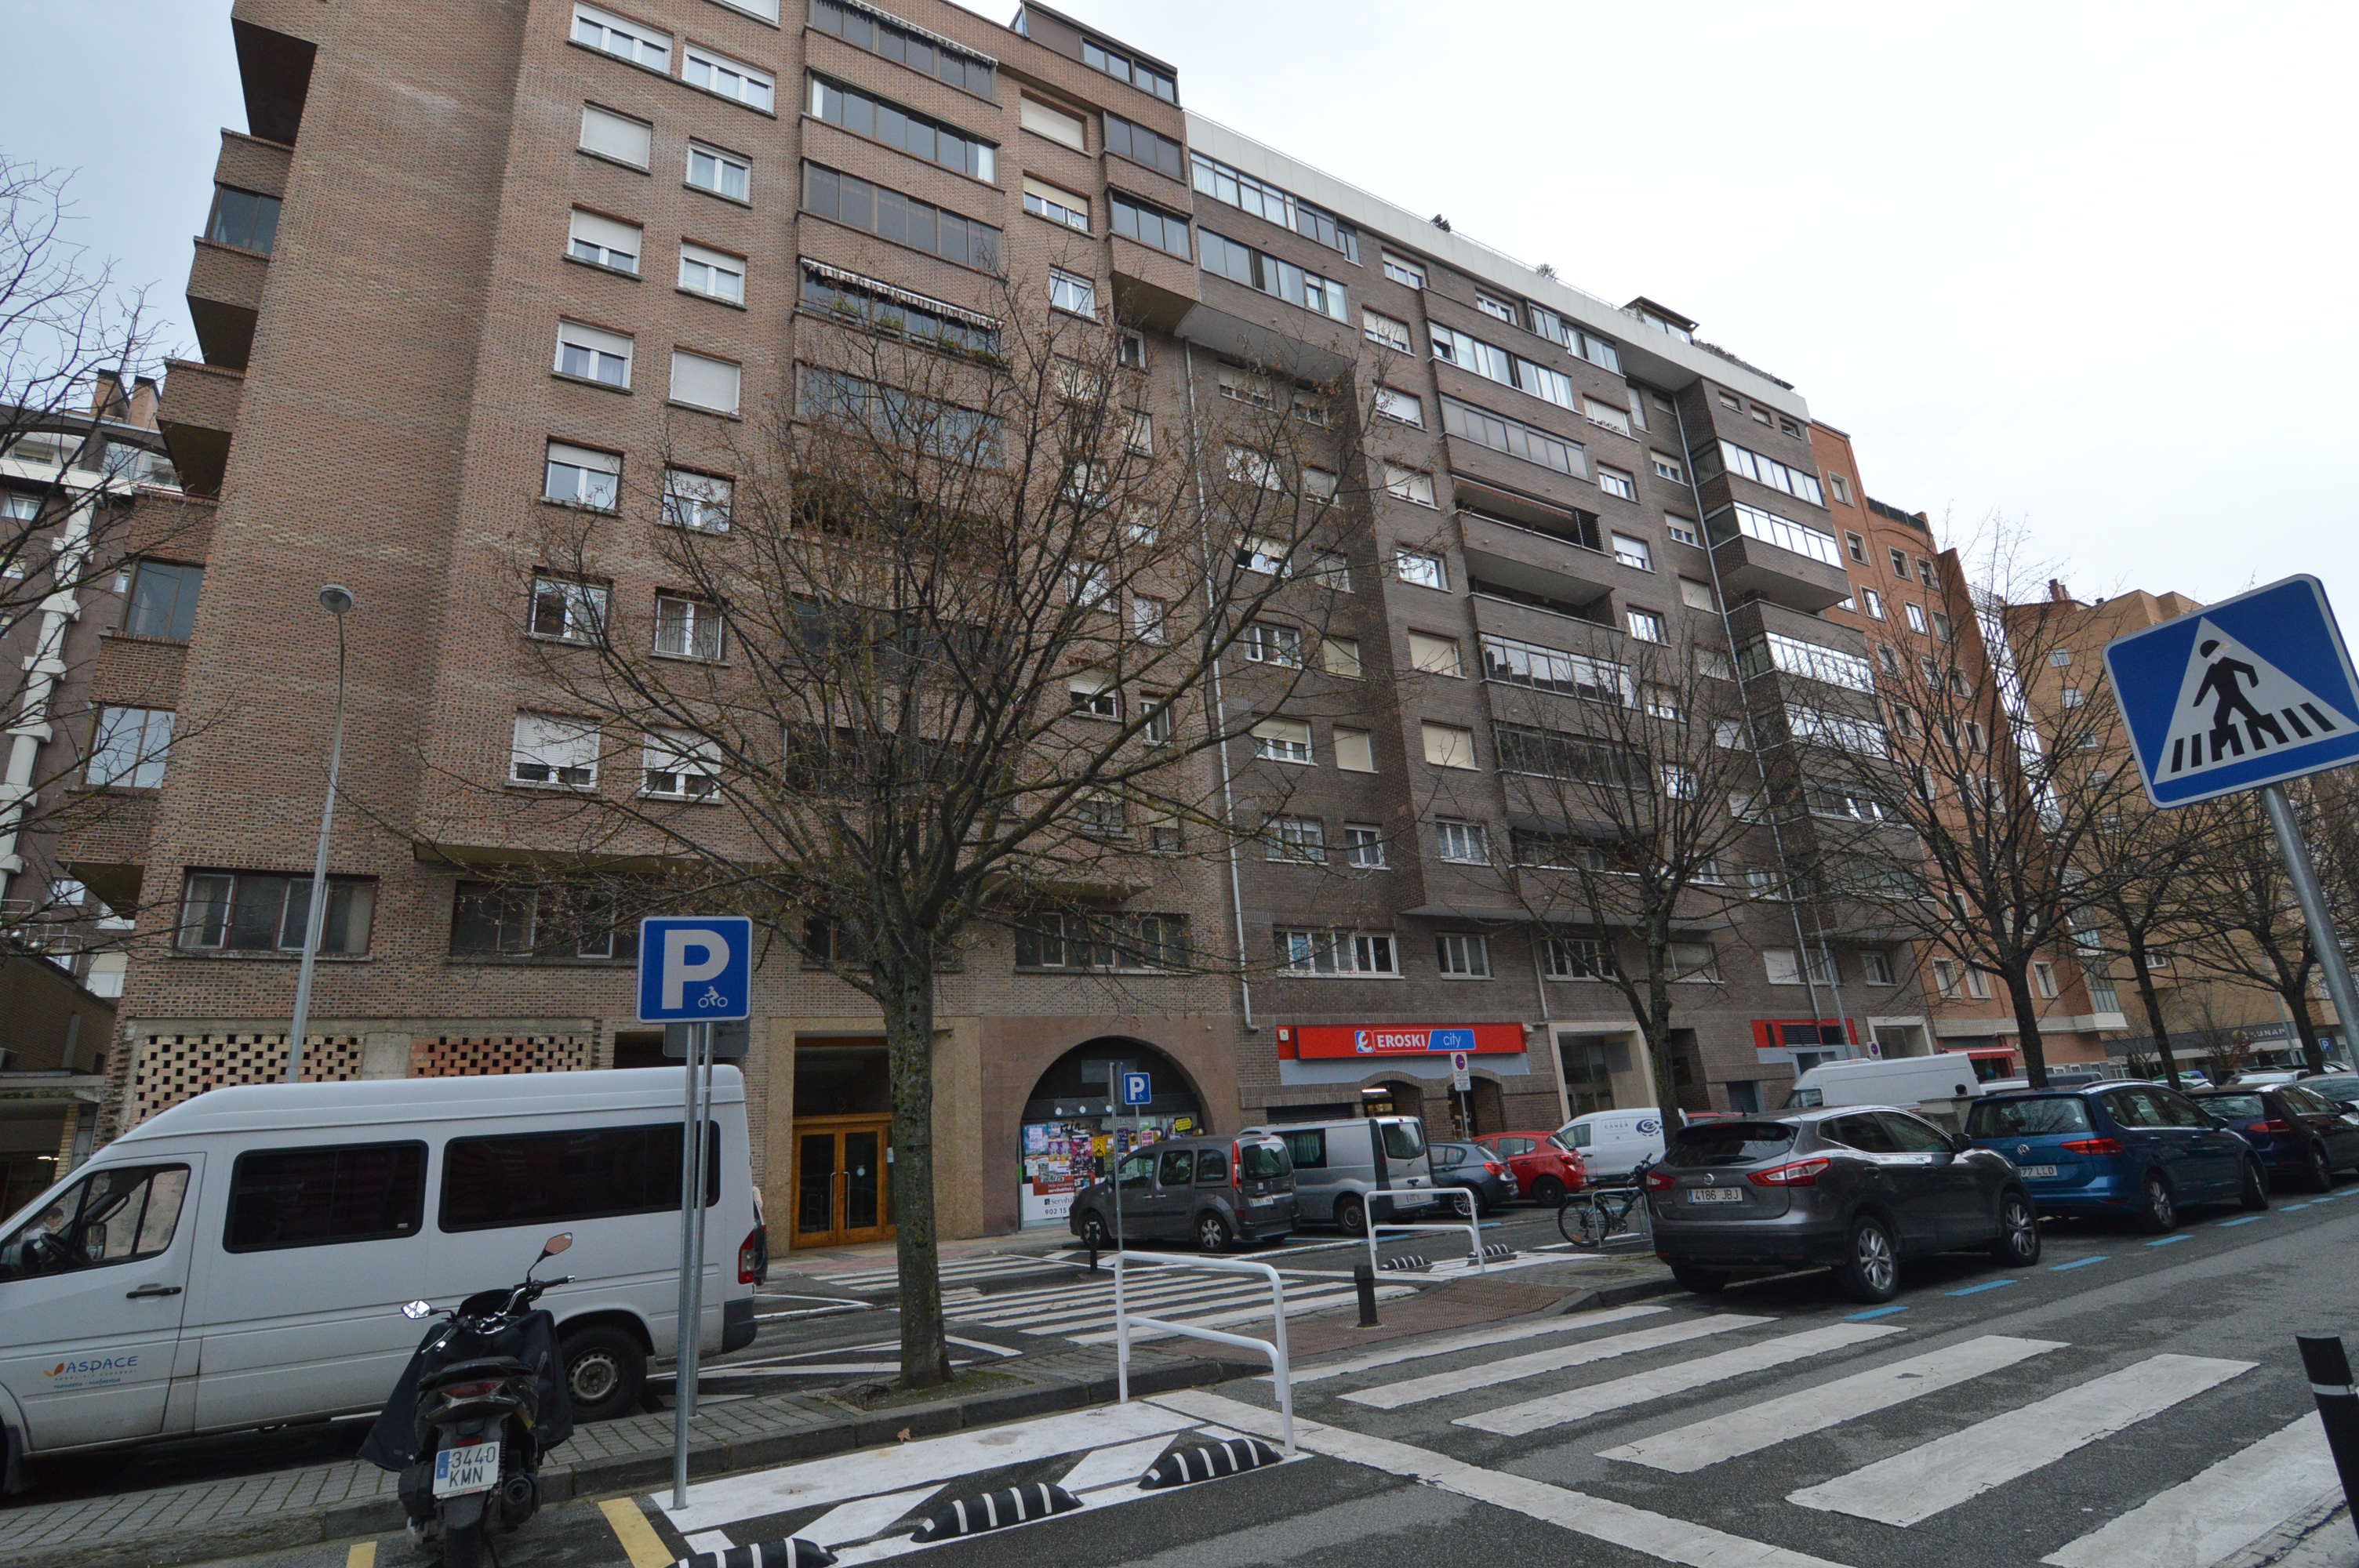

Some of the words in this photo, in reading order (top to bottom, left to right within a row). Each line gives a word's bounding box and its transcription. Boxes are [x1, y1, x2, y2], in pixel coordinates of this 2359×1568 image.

[661, 929, 730, 1010] P
[1377, 1034, 1426, 1047] EROSKI
[1443, 1033, 1462, 1047] city
[2321, 1040, 2329, 1050] P
[1129, 1076, 1145, 1101] P
[1695, 1189, 1717, 1201] 4186
[1721, 1189, 1739, 1200] JBJ
[66, 1356, 139, 1374] ASPACE
[451, 1446, 496, 1468] 3440
[449, 1465, 484, 1488] KMN
